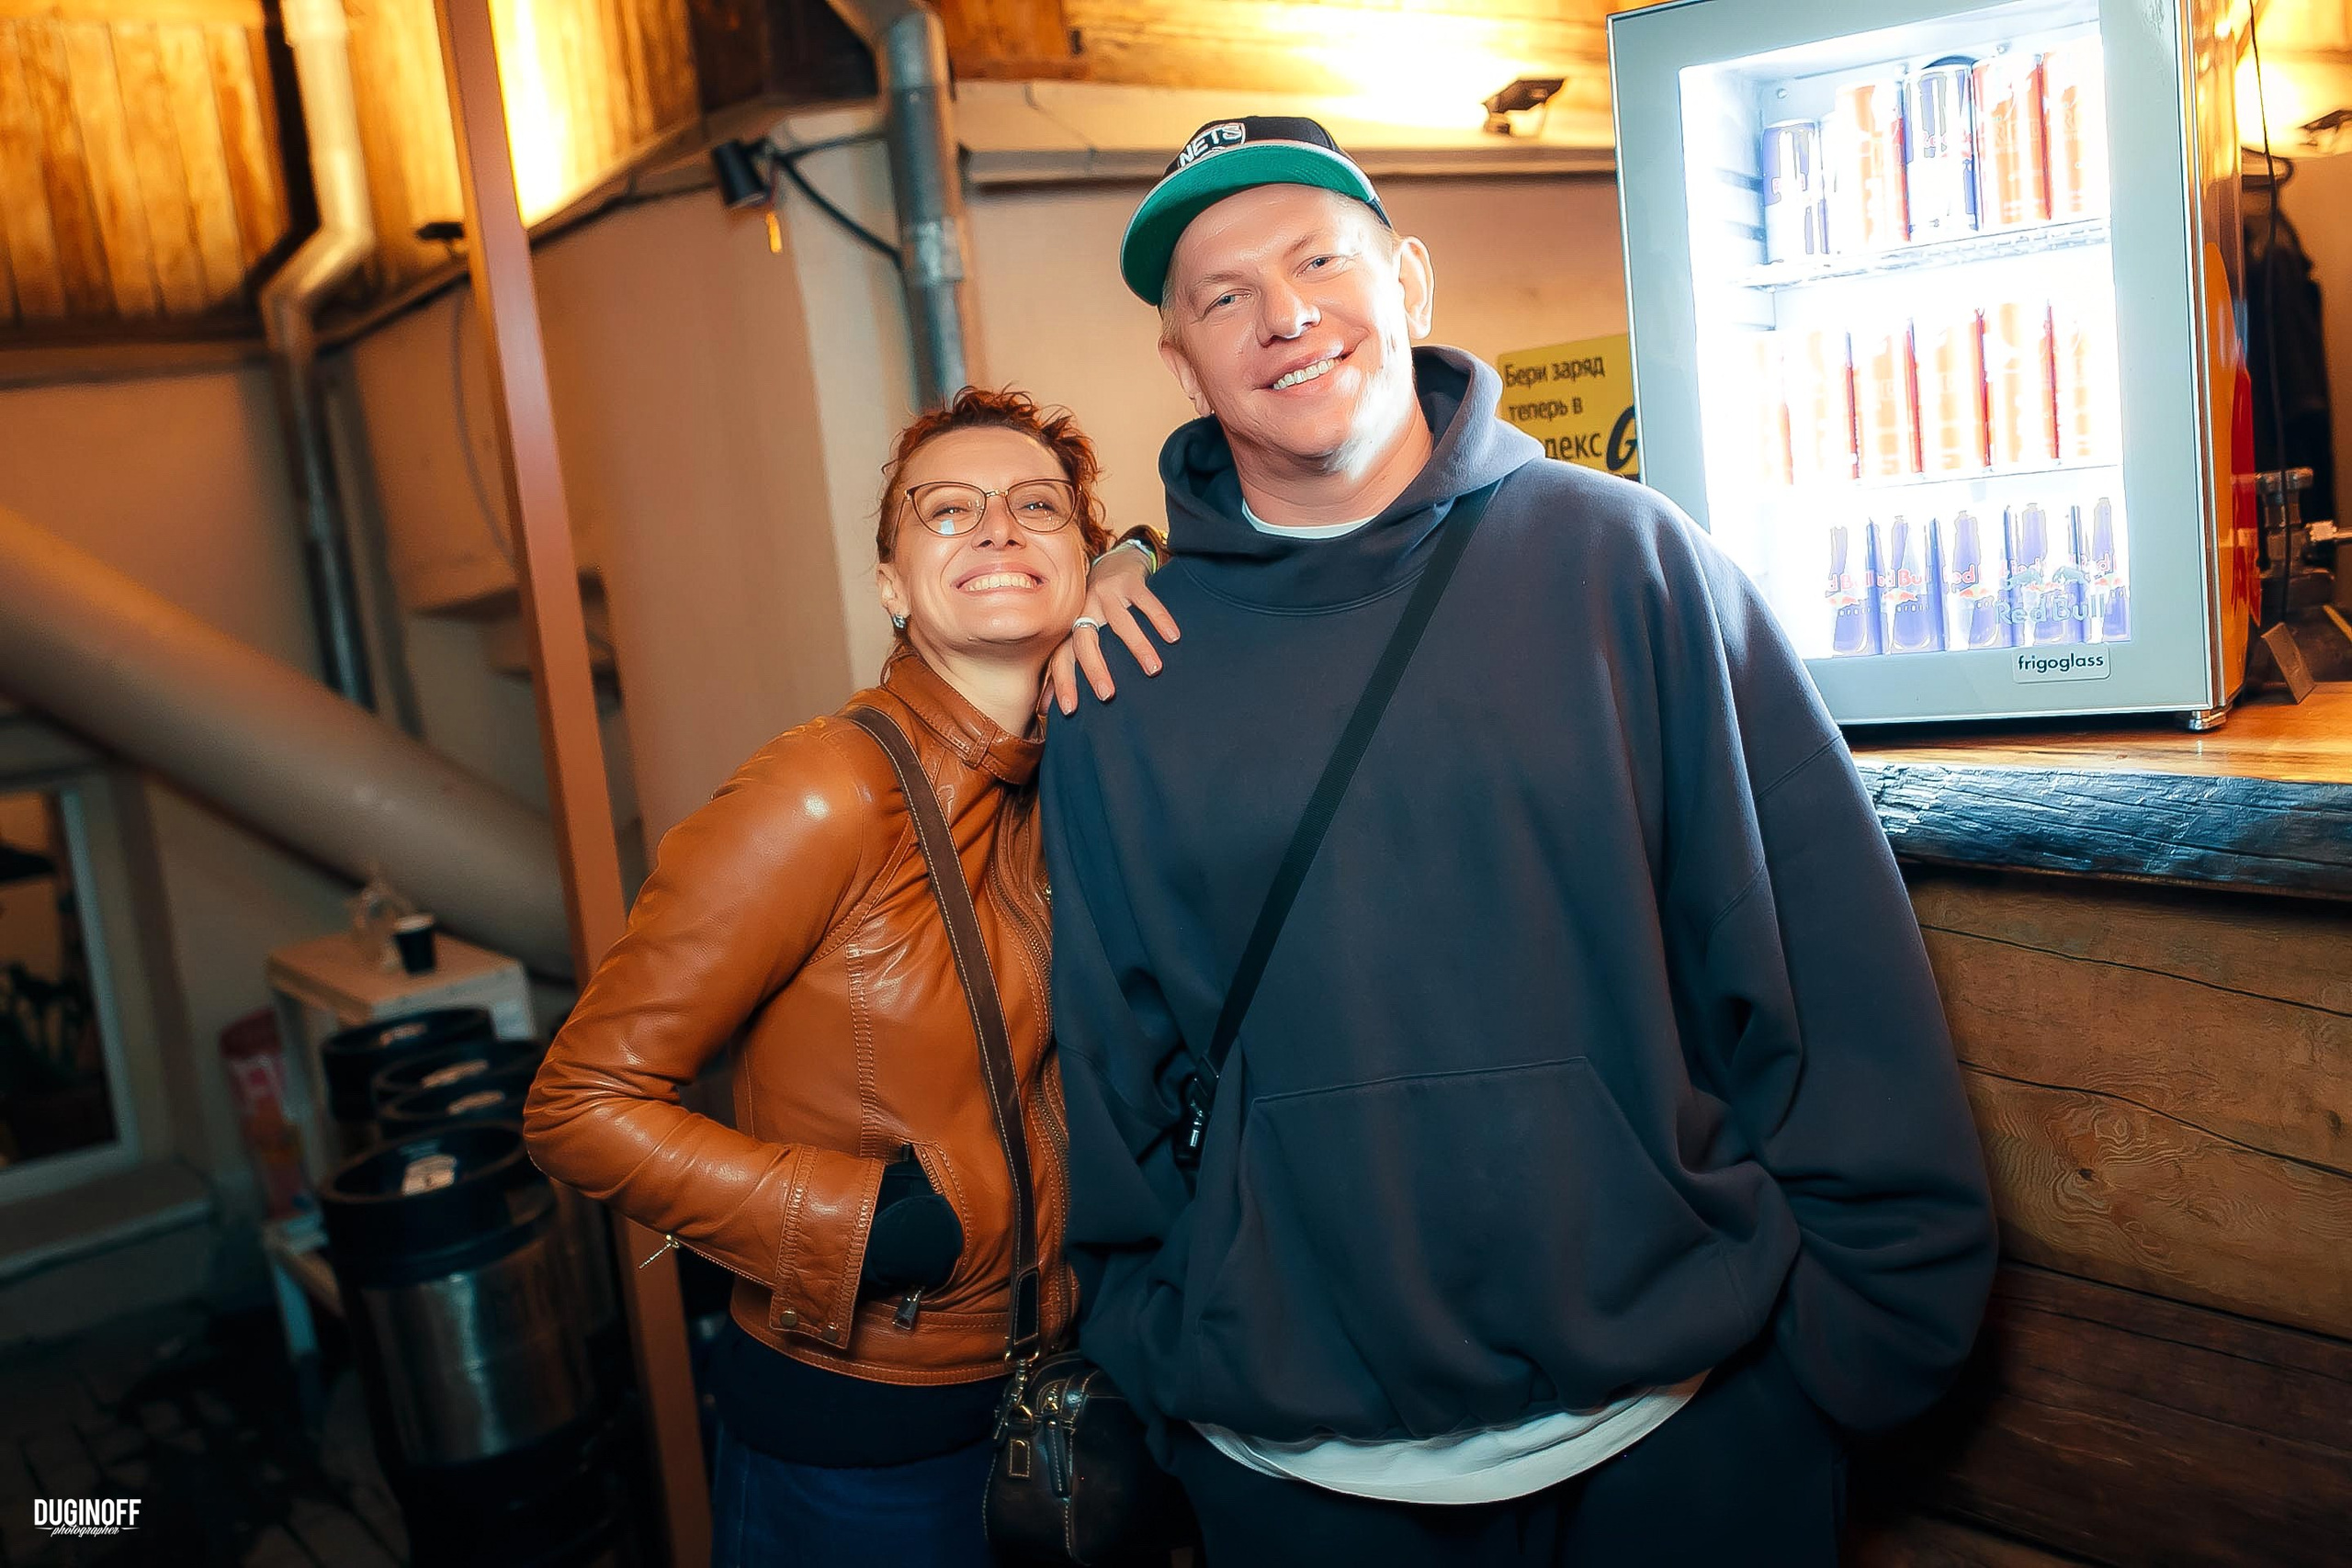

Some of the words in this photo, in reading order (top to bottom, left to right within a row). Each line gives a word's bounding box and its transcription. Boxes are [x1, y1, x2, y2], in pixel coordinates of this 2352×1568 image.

[1179, 123, 1242, 167] NETS
[1505, 364, 1547, 389] Бери
[1552, 356, 1605, 382] заряд
[1509, 400, 1568, 422] теперь
[1572, 396, 1583, 414] в
[1996, 595, 2047, 624] Red
[2052, 593, 2106, 622] Bull
[2018, 652, 2104, 673] frigoglass
